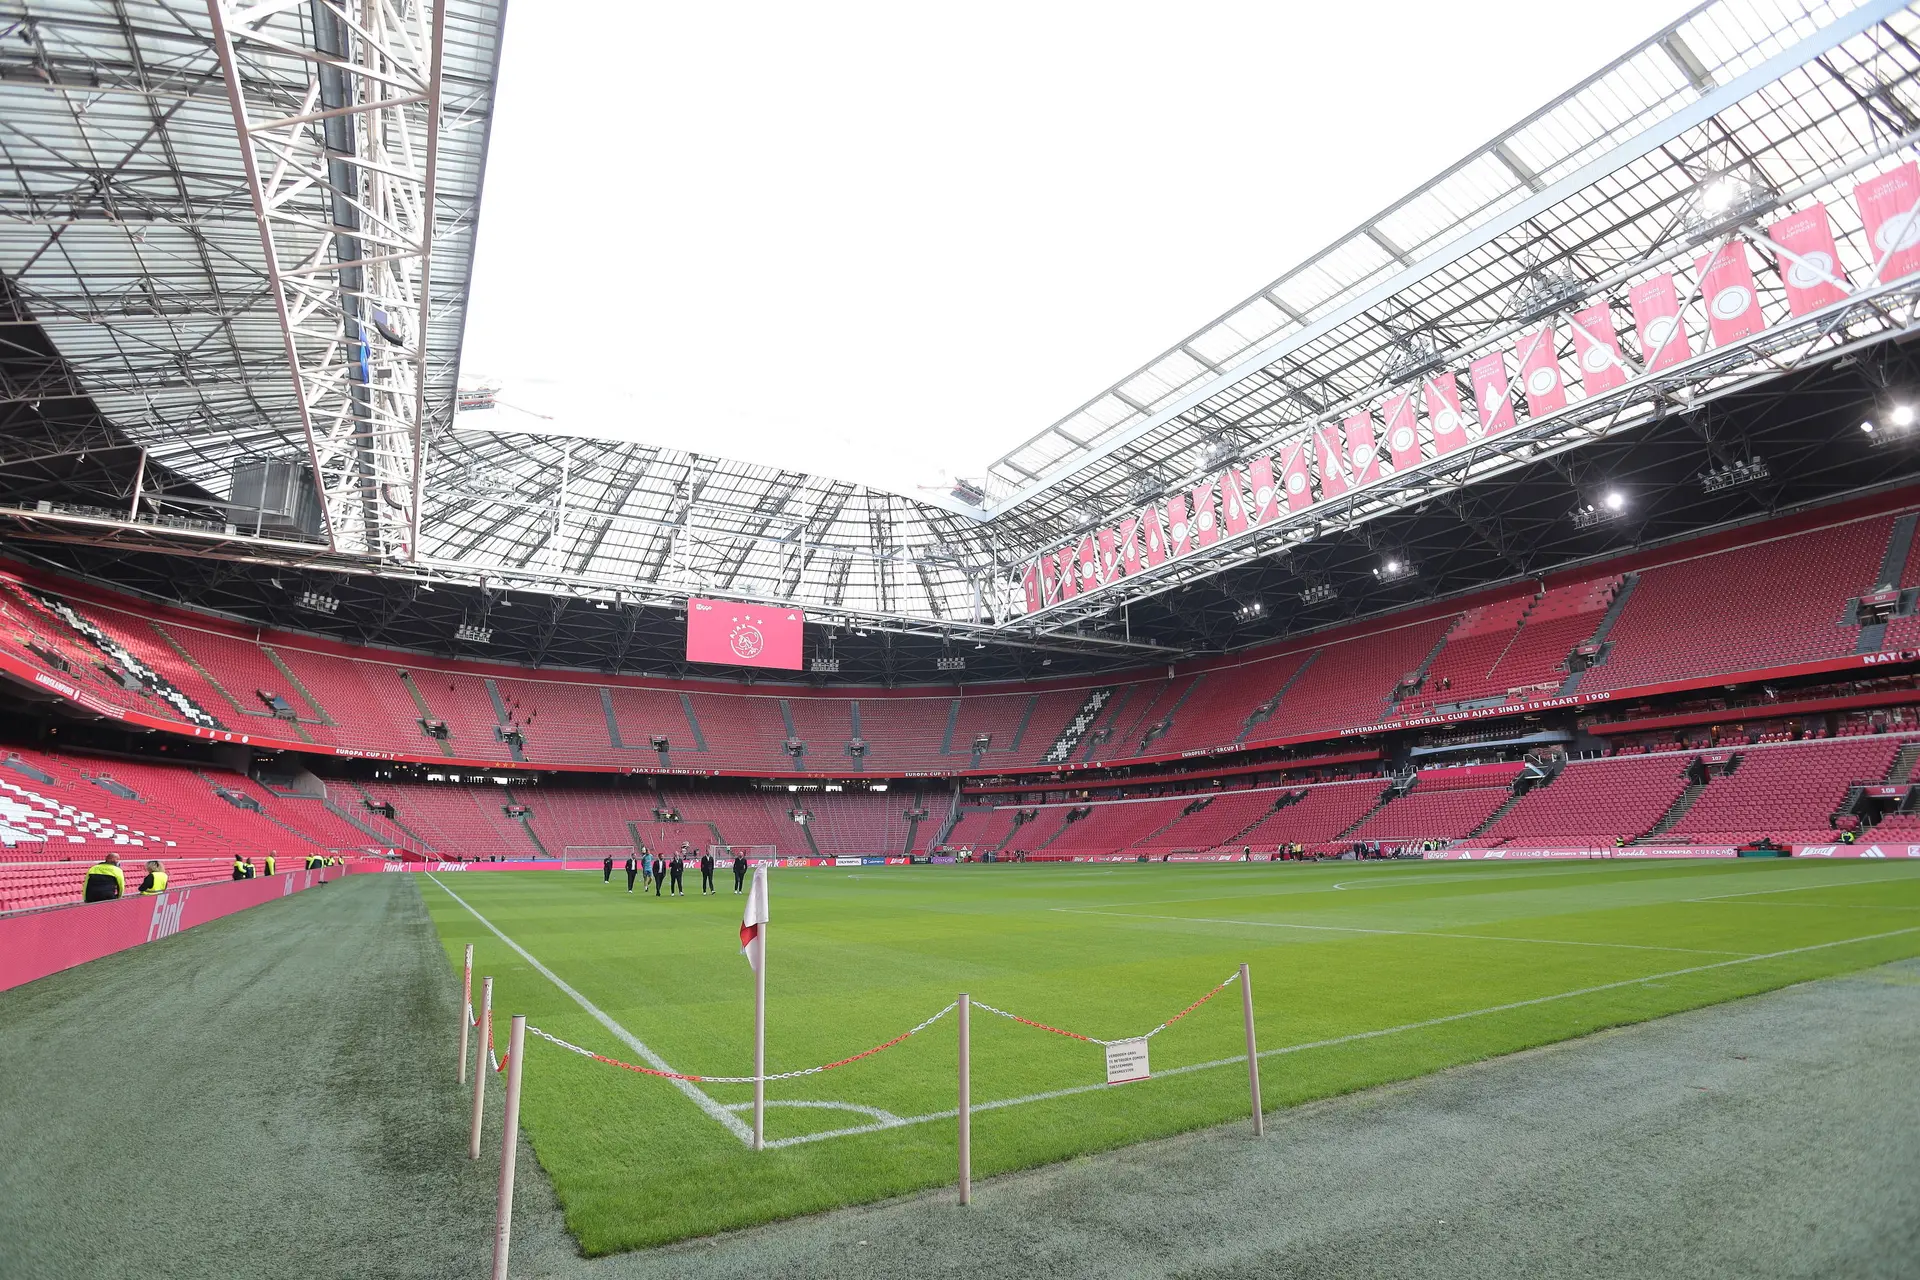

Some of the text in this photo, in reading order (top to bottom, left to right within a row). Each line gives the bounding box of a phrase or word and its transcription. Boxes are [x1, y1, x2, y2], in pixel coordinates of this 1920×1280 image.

[729, 623, 747, 640] AJAX
[35, 672, 75, 697] LANDSKAMPIOEN
[1340, 692, 1610, 736] AMSTERDAMSCHE FOOTBALL CLUB AJAX SINDS 18 MAART 1900
[335, 748, 363, 757] EUROPA
[1182, 749, 1206, 758] EUROPESE
[1616, 848, 1647, 857] Sandals
[383, 862, 407, 873] Flink
[437, 862, 468, 872] Flink
[146, 890, 190, 942] Flink
